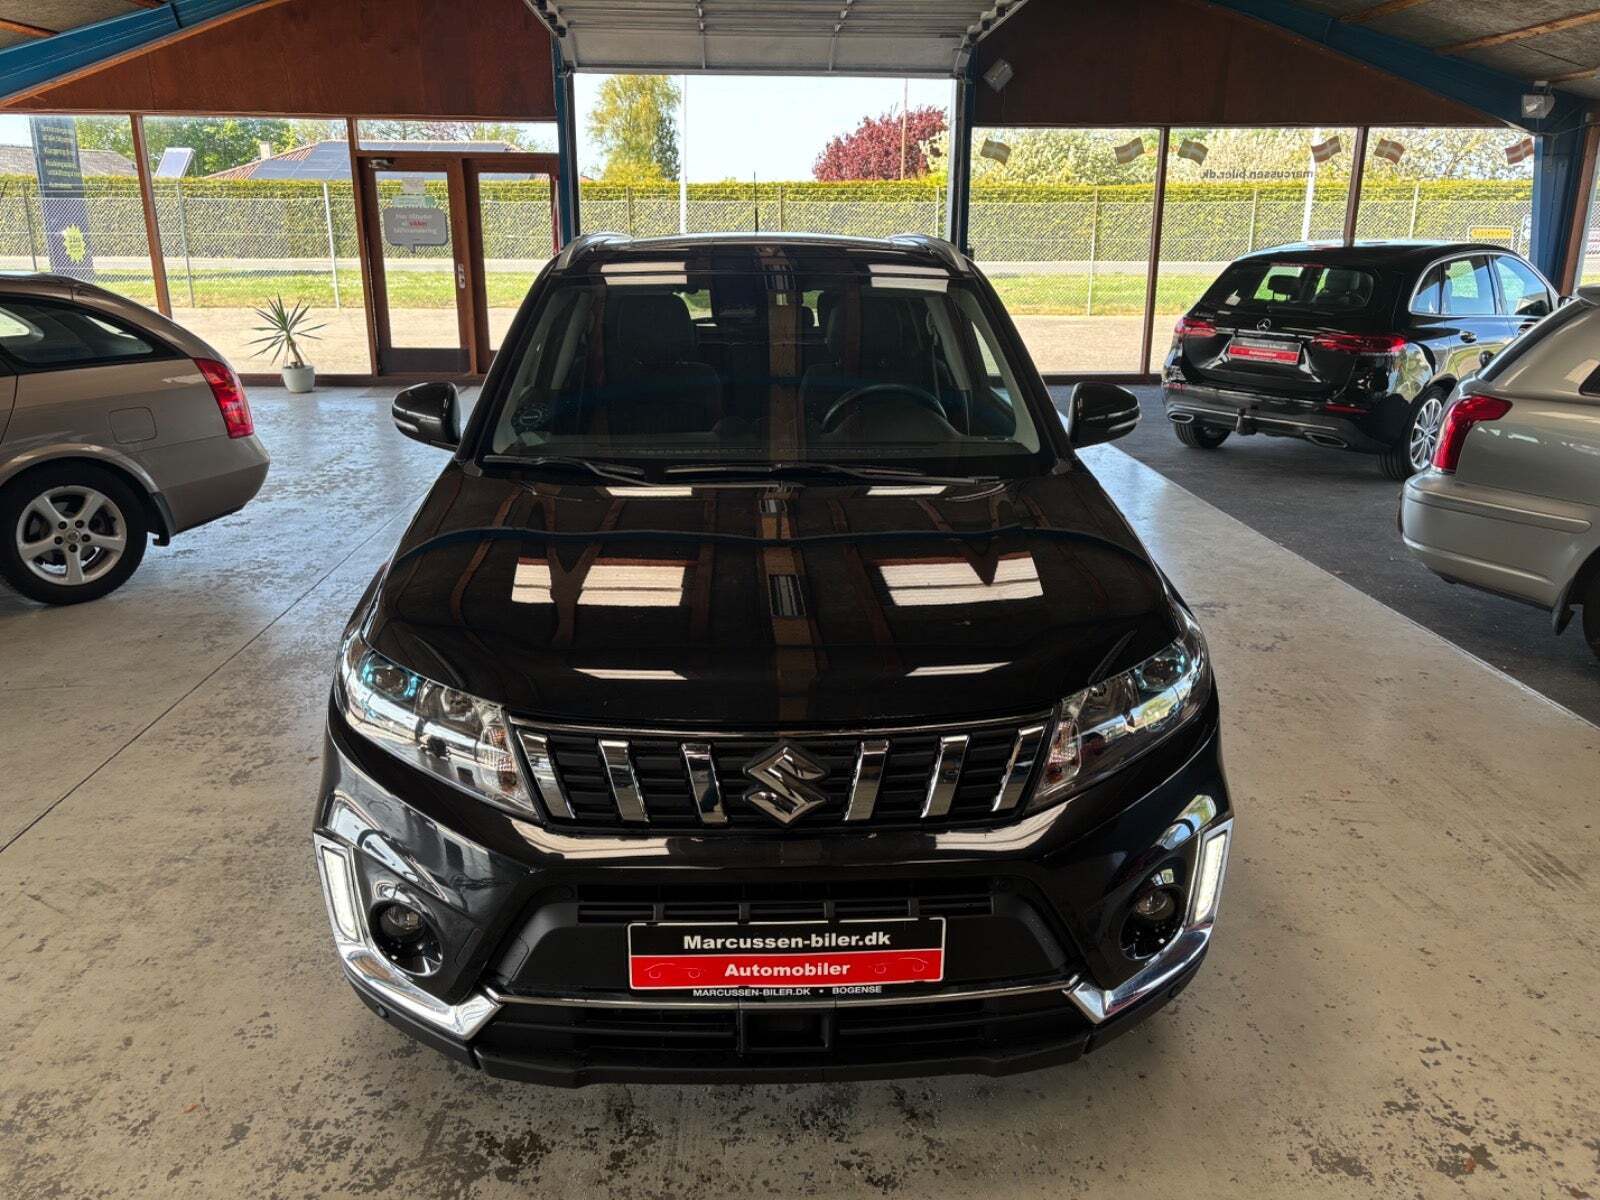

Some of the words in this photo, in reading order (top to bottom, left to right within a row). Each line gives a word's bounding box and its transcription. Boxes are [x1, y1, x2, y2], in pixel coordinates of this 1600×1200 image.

[683, 931, 891, 950] Marcussen-biler.dk
[724, 962, 851, 977] Automobiler
[692, 987, 811, 997] MARCUSSEN-BILER.DK
[831, 985, 882, 995] BOGENSE
